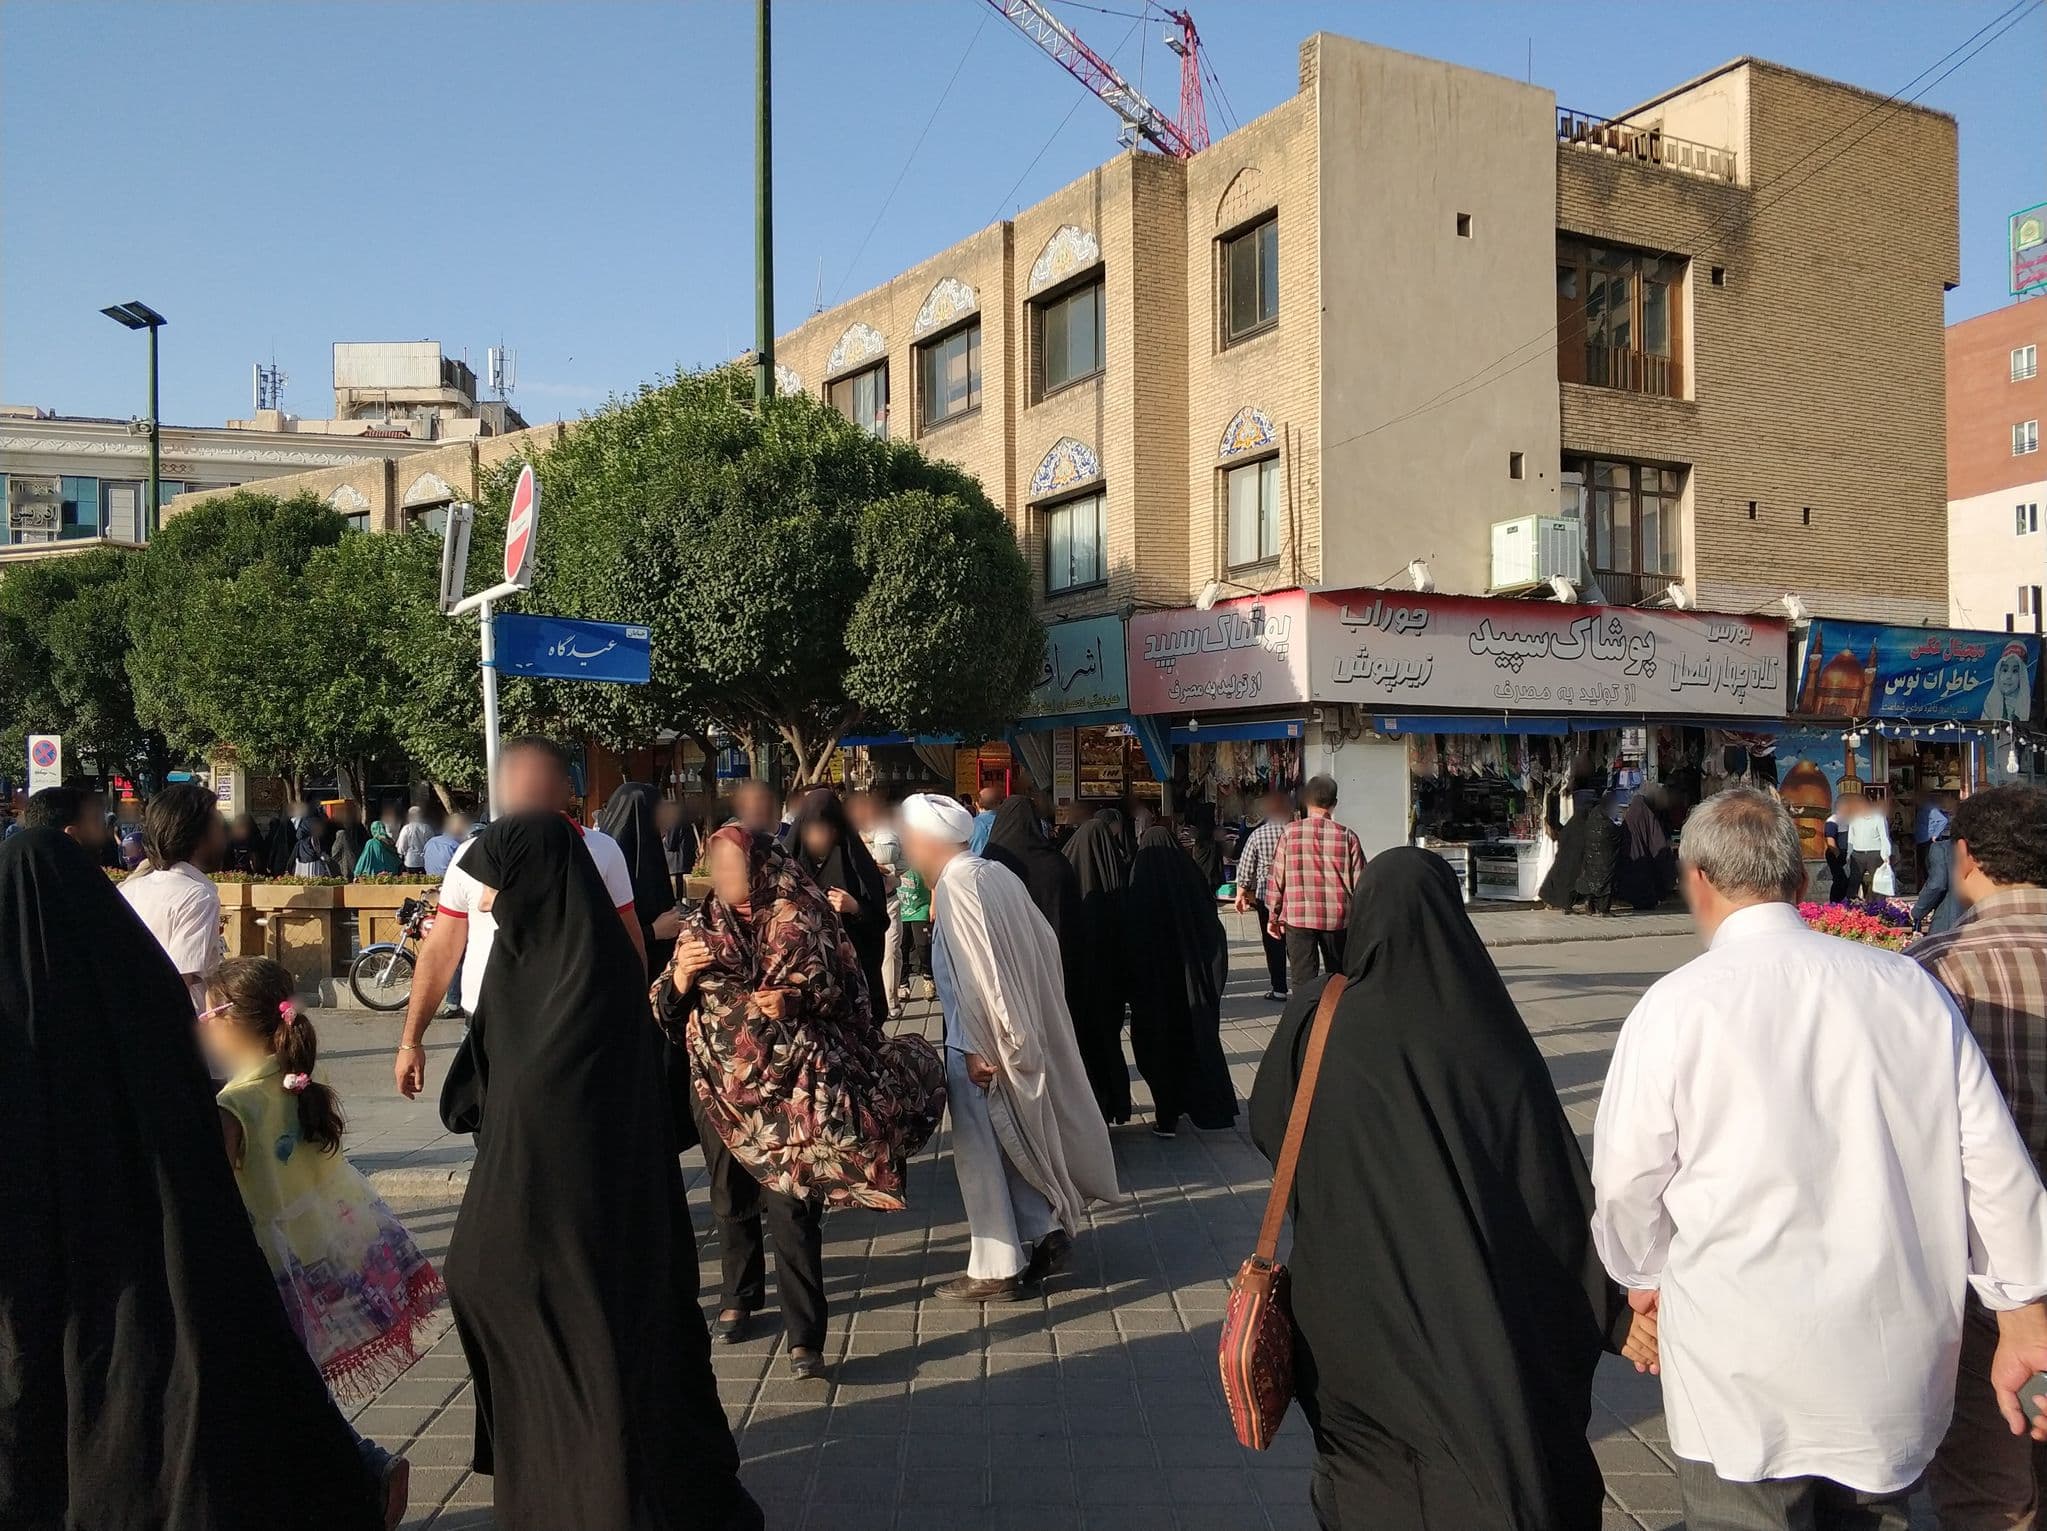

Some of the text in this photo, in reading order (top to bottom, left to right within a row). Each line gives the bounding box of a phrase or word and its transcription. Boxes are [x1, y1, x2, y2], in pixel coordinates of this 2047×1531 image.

[10, 505, 57, 526] ادریس
[1339, 599, 1430, 637] جوراب
[1705, 621, 1754, 645] بورس
[547, 633, 618, 667] عیدگاه
[1143, 602, 1292, 674] پوشاک سپید
[1469, 615, 1658, 678] پوشاک سپید
[1910, 635, 1942, 660] عکس
[1332, 643, 1434, 692] زیرپوش
[1669, 651, 1711, 692] فصل
[1751, 656, 1778, 690] کلاه
[1884, 666, 1980, 699] خاطرات توس
[1168, 671, 1263, 704] از تولید به مصرف
[1493, 683, 1637, 706] از تولید به مصرف
